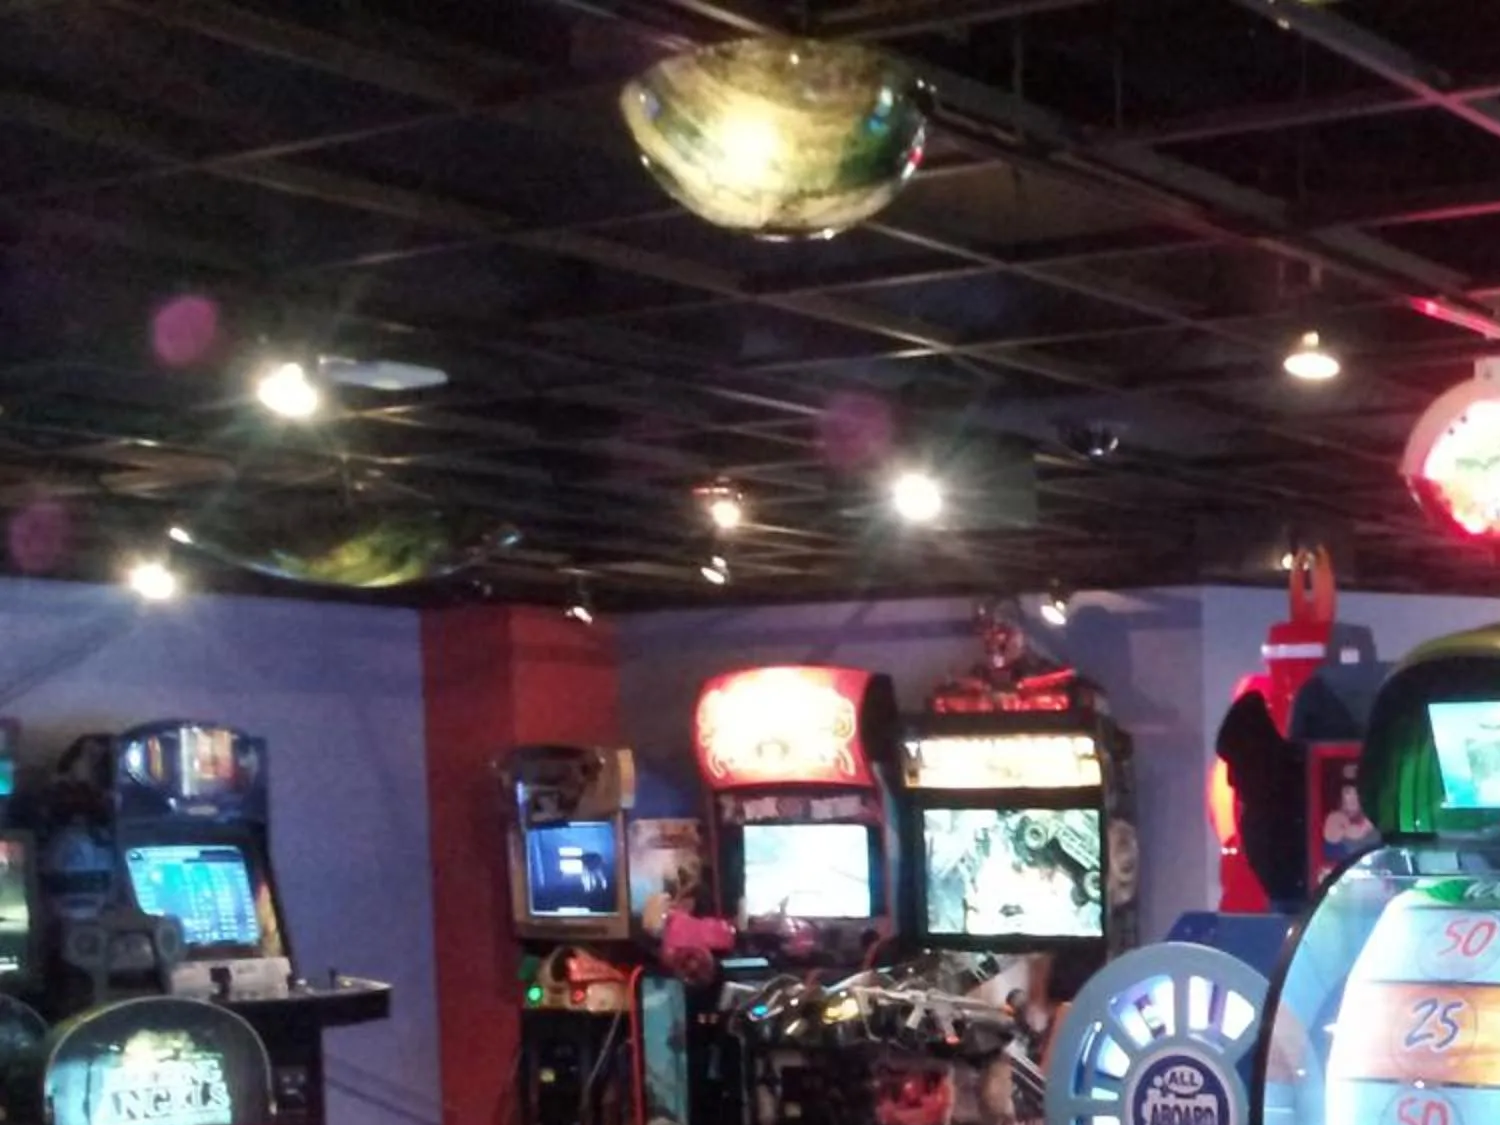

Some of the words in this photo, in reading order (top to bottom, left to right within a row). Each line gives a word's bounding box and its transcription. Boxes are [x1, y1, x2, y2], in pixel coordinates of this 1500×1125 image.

[1437, 916, 1499, 957] 50
[1404, 997, 1464, 1049] 25
[1168, 1071, 1199, 1086] ALL
